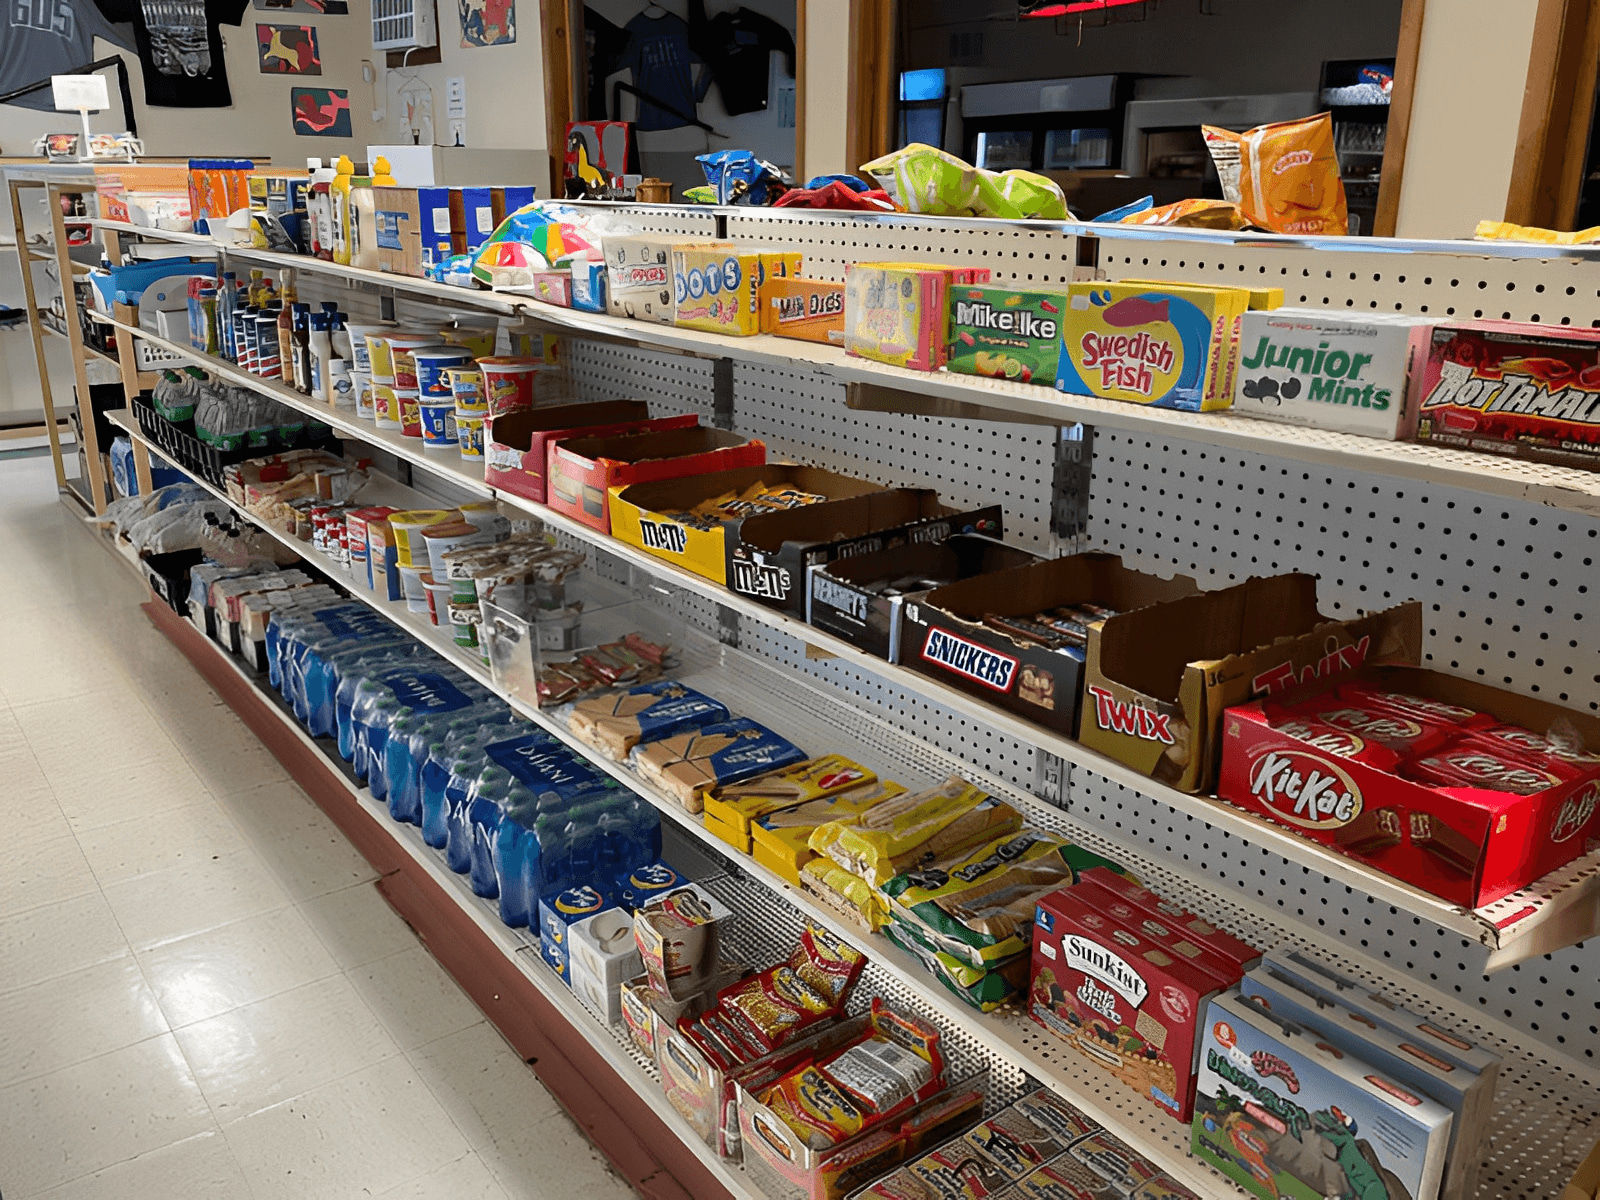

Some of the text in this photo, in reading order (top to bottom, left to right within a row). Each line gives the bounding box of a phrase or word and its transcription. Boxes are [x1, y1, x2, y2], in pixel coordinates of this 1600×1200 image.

[674, 257, 741, 304] DOTS
[956, 301, 1058, 339] Mike Ike
[1081, 332, 1174, 373] Swedish
[1241, 336, 1373, 381] Junior
[1101, 358, 1154, 394] Fish
[1308, 377, 1392, 411] Mints
[926, 630, 1013, 688] SNICKERS
[1069, 937, 1142, 997] Sunkist
